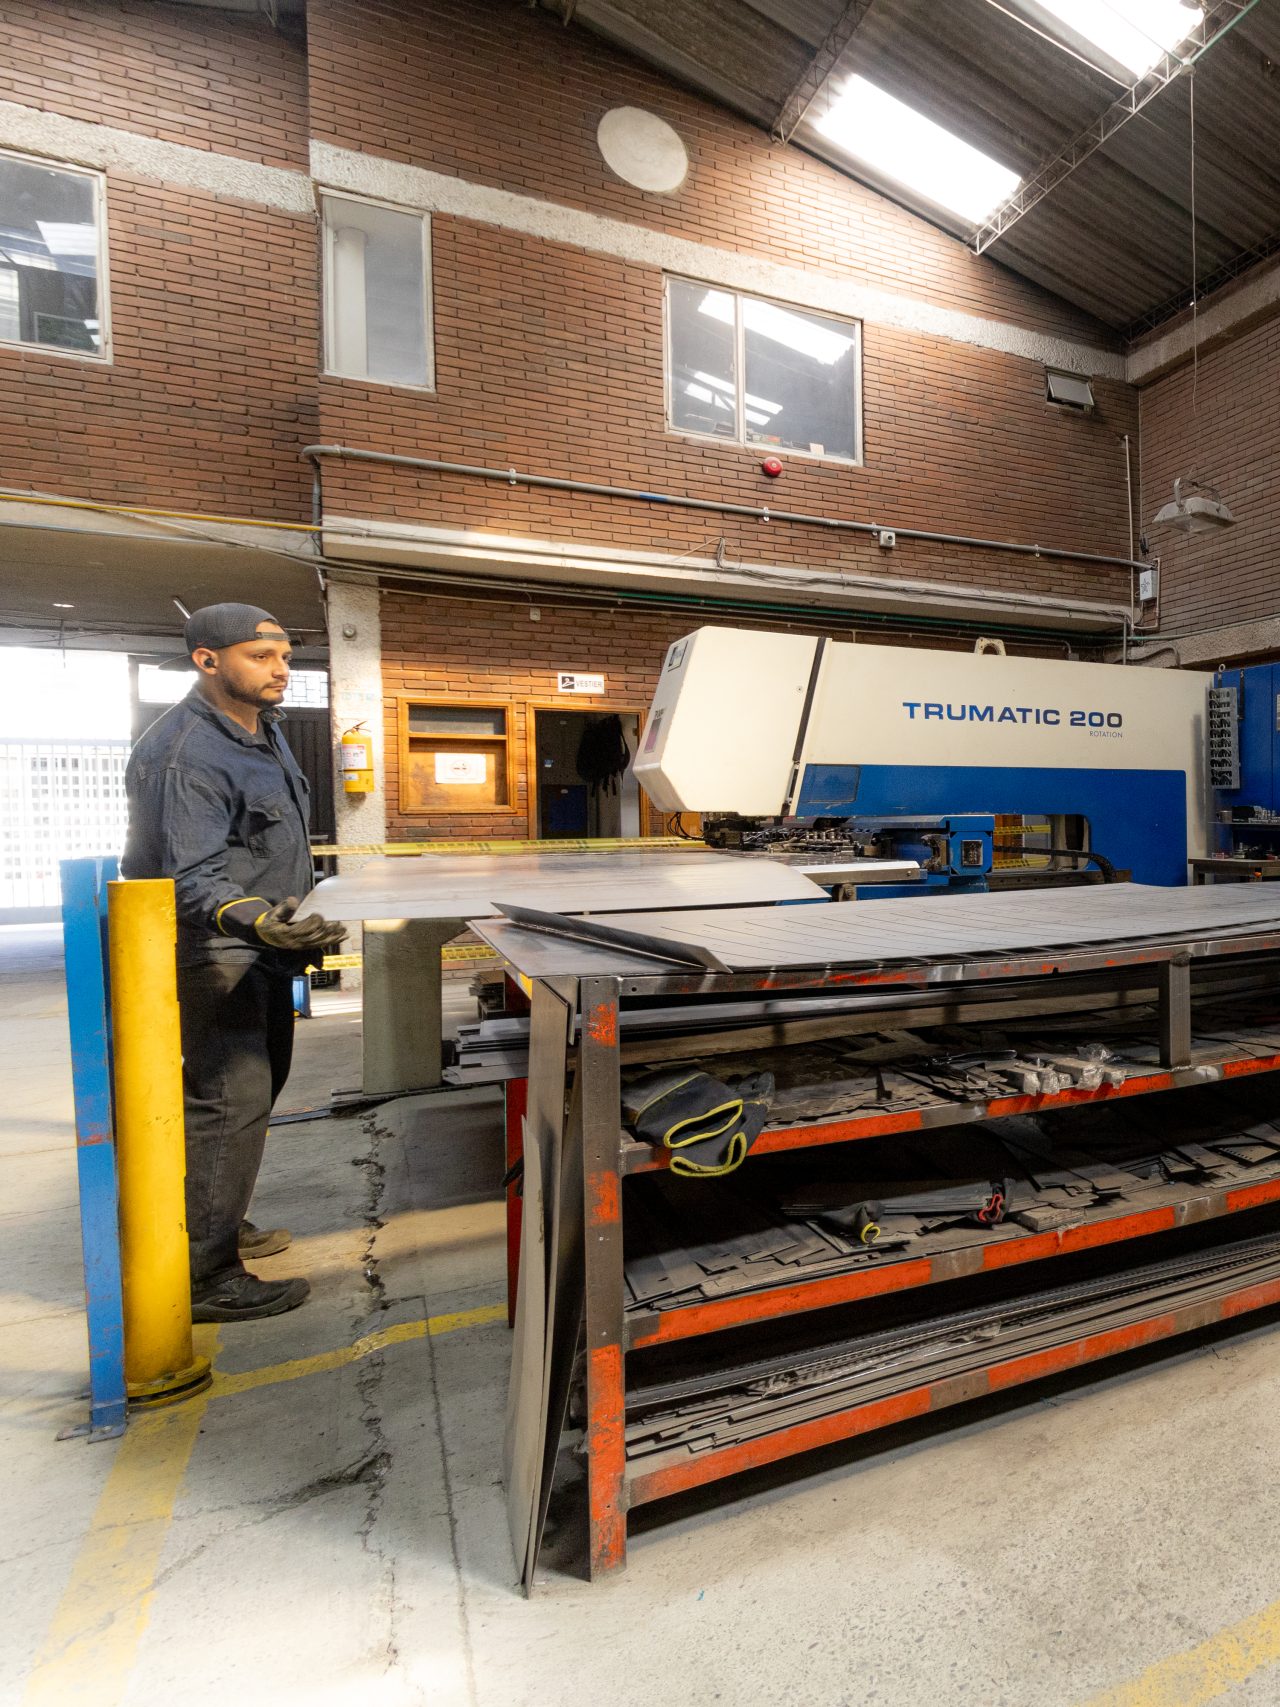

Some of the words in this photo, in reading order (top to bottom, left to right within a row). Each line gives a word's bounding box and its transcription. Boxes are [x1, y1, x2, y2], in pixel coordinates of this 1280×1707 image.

[902, 702, 1061, 726] TRUMATIC
[1069, 710, 1123, 728] 200
[1089, 730, 1123, 738] ROTATION
